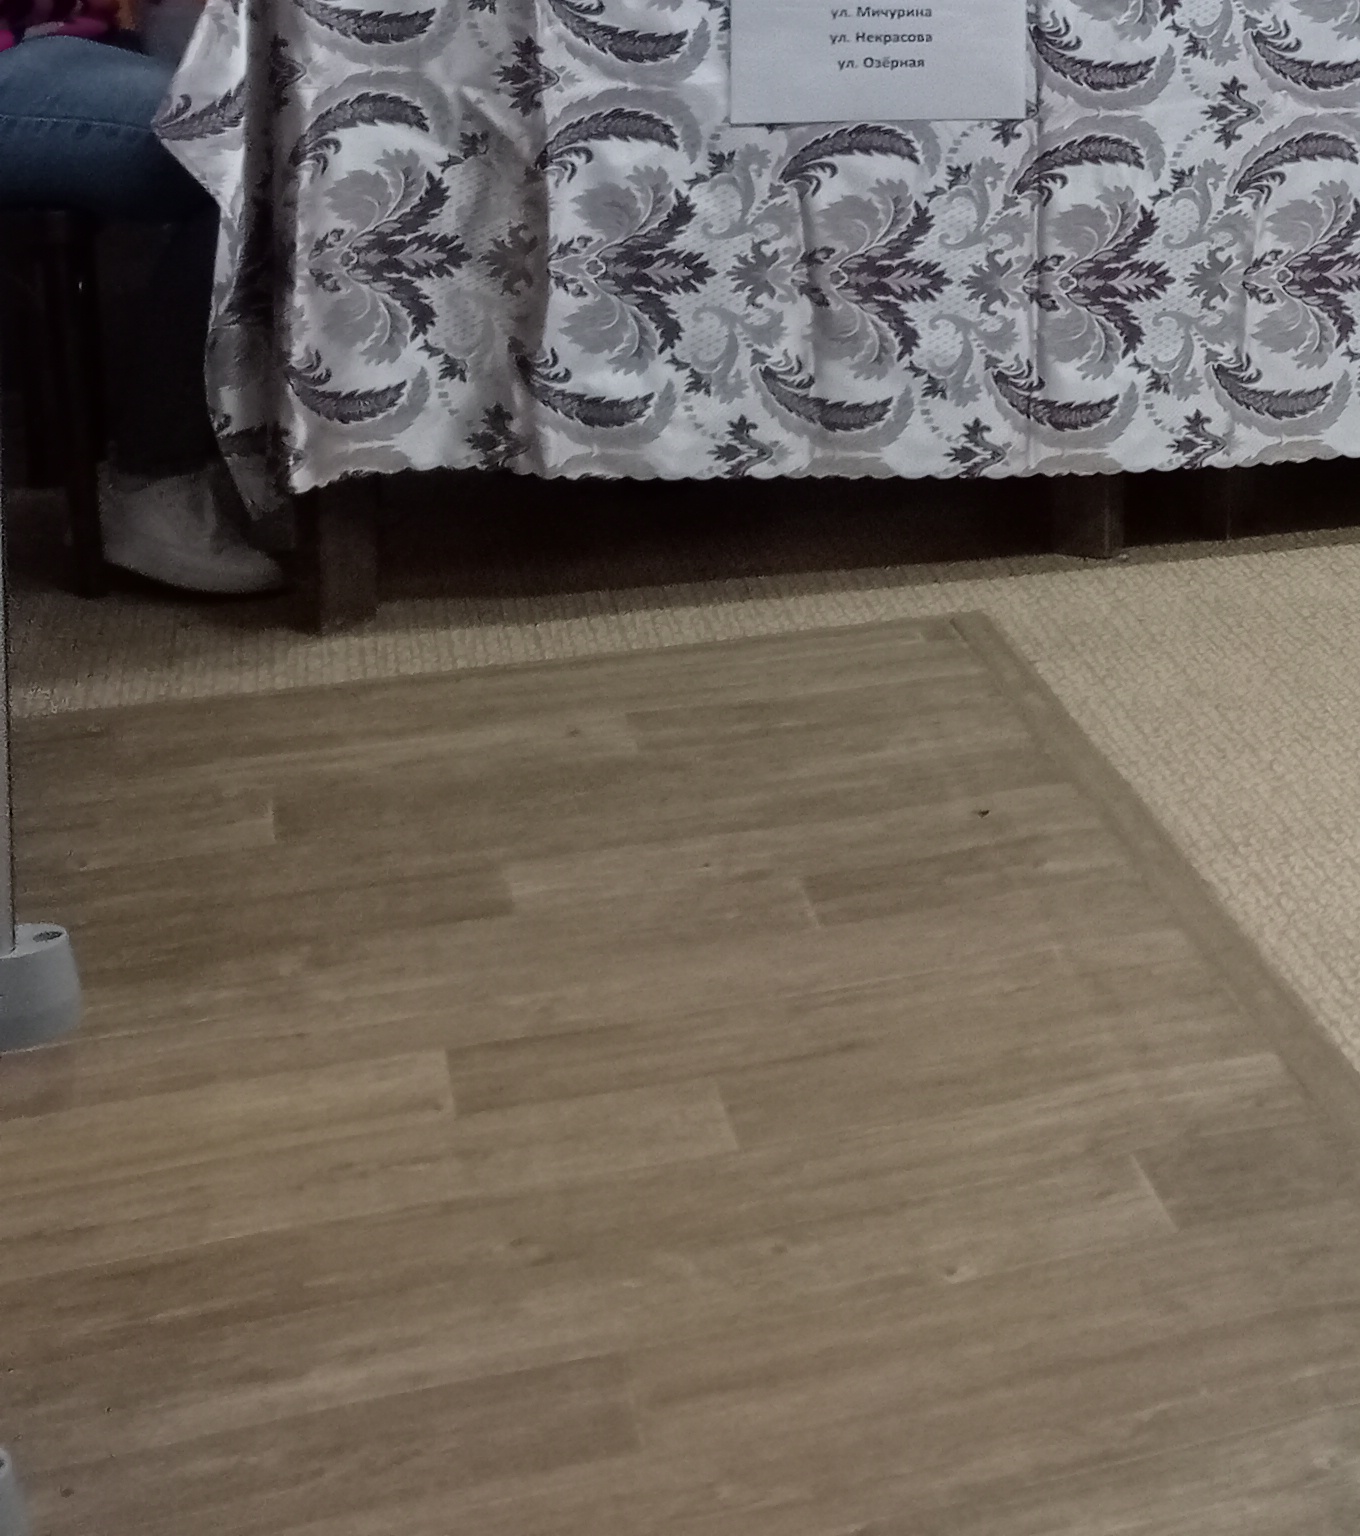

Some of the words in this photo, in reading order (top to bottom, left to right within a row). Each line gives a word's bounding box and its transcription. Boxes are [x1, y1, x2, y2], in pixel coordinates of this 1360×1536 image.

[831, 7, 851, 20] ул.
[856, 5, 933, 19] Мичурина
[830, 32, 850, 45] ул.
[856, 31, 933, 45] Некрасова
[837, 58, 858, 71] ул.
[863, 56, 925, 71] Озёрная
